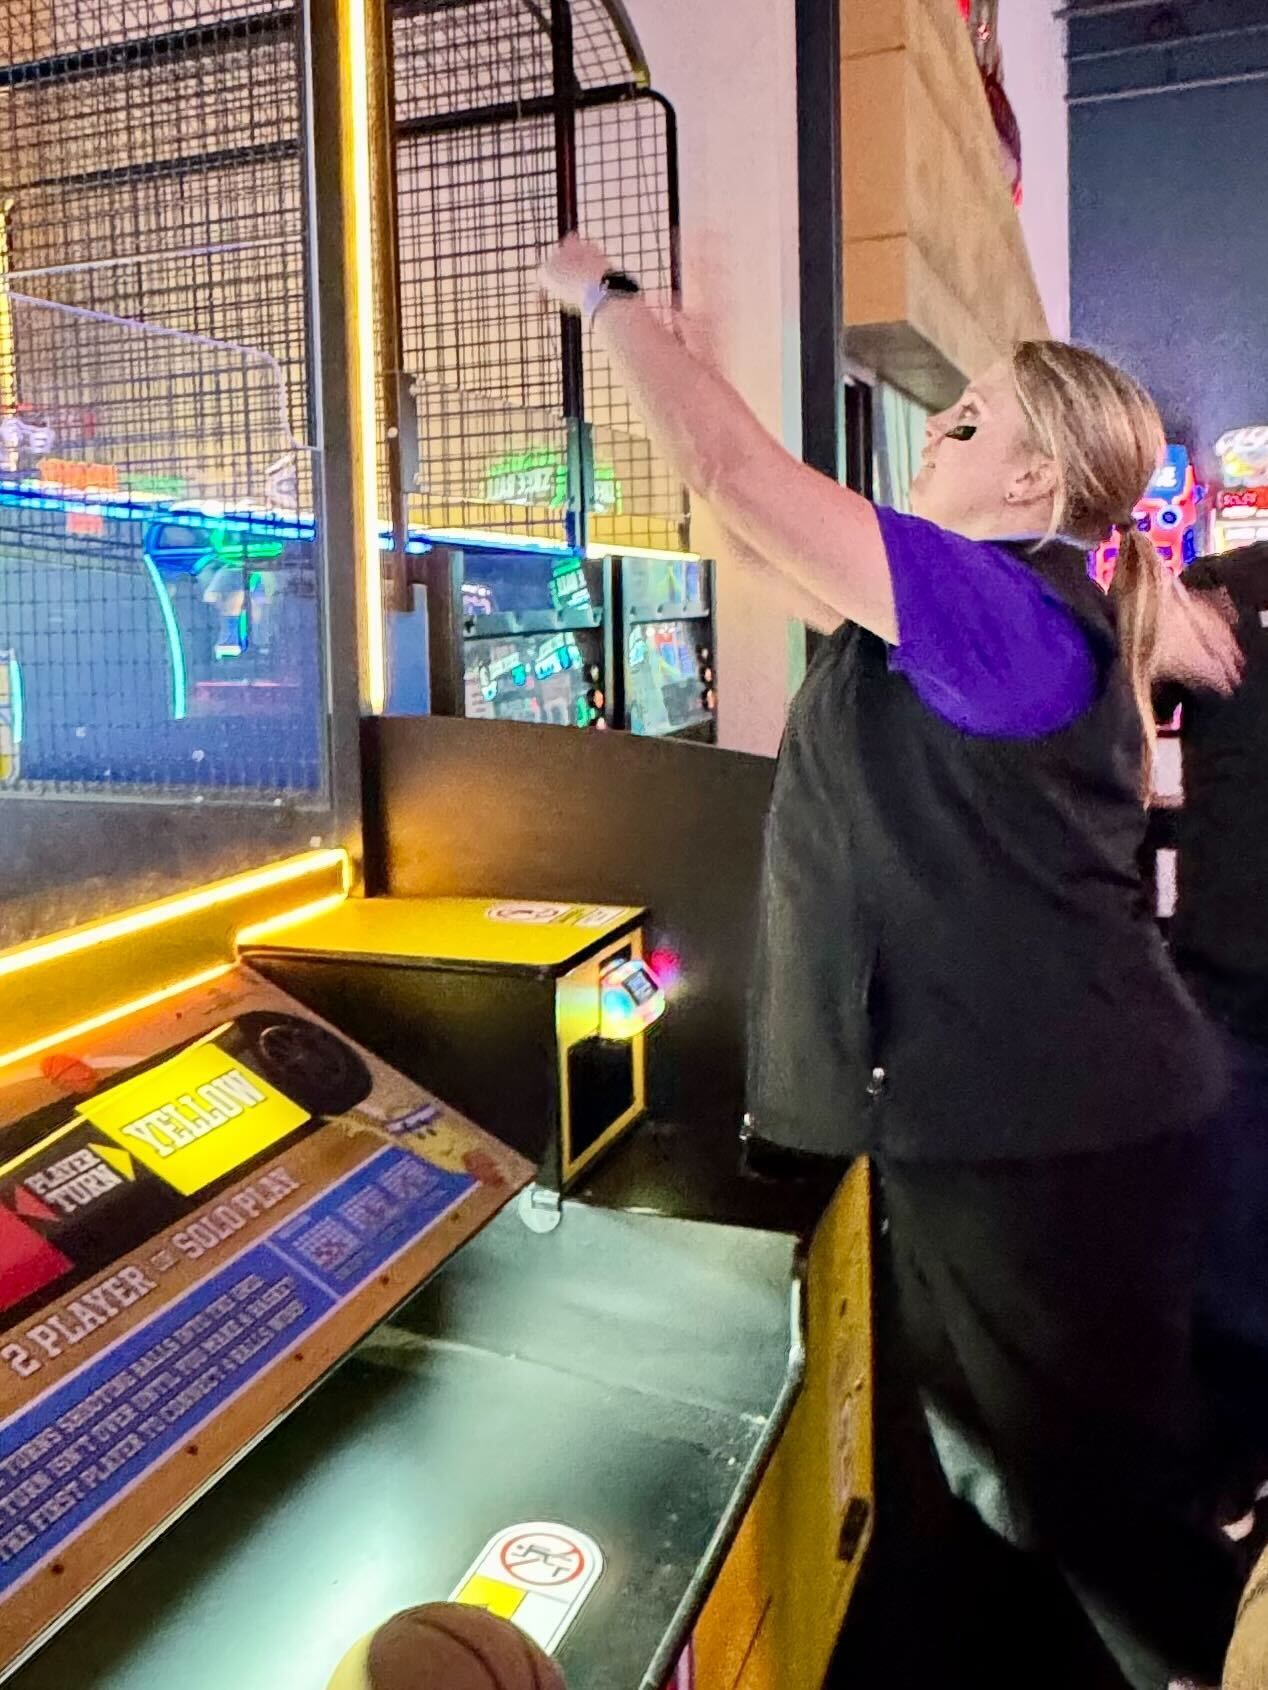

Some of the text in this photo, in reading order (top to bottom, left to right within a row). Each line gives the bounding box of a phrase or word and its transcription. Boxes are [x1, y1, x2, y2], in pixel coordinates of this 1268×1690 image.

[121, 1069, 267, 1157] YELLOW
[24, 1148, 101, 1195] PLAYER
[43, 1163, 125, 1213] TURN
[3, 1342, 41, 1378] 2
[25, 1266, 157, 1358] PLAYER
[172, 1204, 248, 1259] SOLO
[231, 1166, 300, 1218] PLAY
